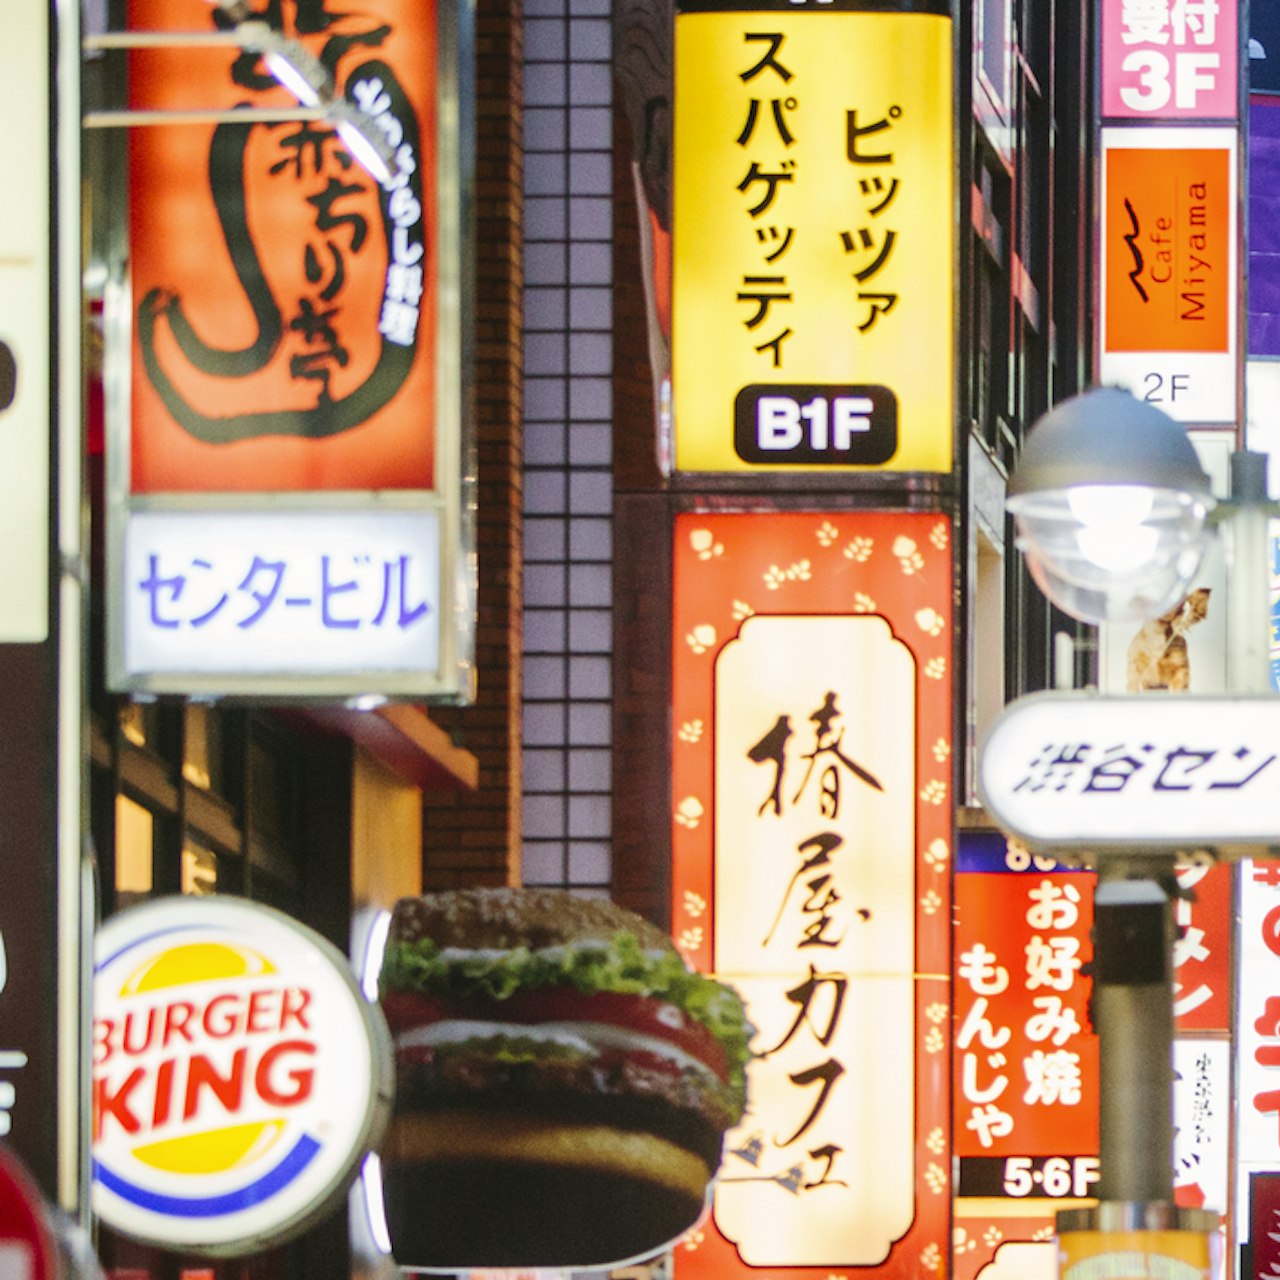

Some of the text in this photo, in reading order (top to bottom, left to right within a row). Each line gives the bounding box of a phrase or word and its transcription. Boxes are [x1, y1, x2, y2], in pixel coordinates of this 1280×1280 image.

[1119, 51, 1219, 111] 3F
[736, 31, 797, 369] スパゲッティ
[839, 104, 902, 334] ピッツァ
[1149, 216, 1173, 284] Cafe
[1181, 180, 1207, 322] Miyama
[756, 397, 874, 451] B1F
[1143, 373, 1191, 403] 2F
[138, 552, 429, 632] センタービル
[746, 691, 885, 1191] 椿屋カフェ
[1022, 880, 1083, 1106] お好み焼
[93, 1041, 318, 1142] KING
[957, 943, 1014, 1148] もんじゃ
